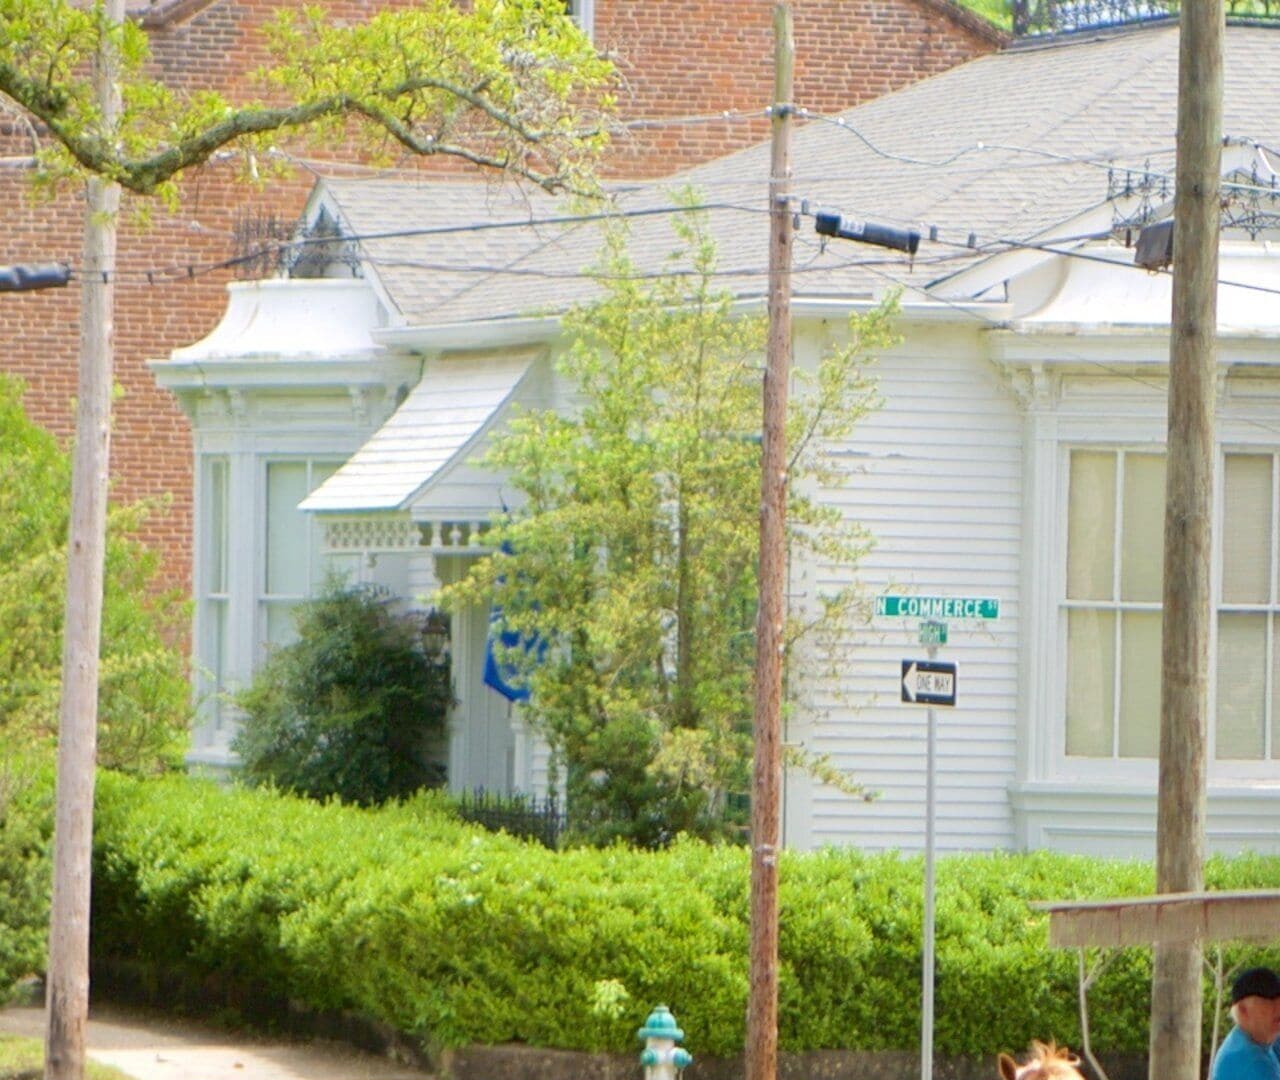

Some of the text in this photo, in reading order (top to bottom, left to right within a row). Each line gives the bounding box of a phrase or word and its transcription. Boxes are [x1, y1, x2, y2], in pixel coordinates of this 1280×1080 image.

[876, 597, 886, 615] N
[898, 598, 982, 617] COMMERCE
[917, 674, 950, 690] ONE WAY
